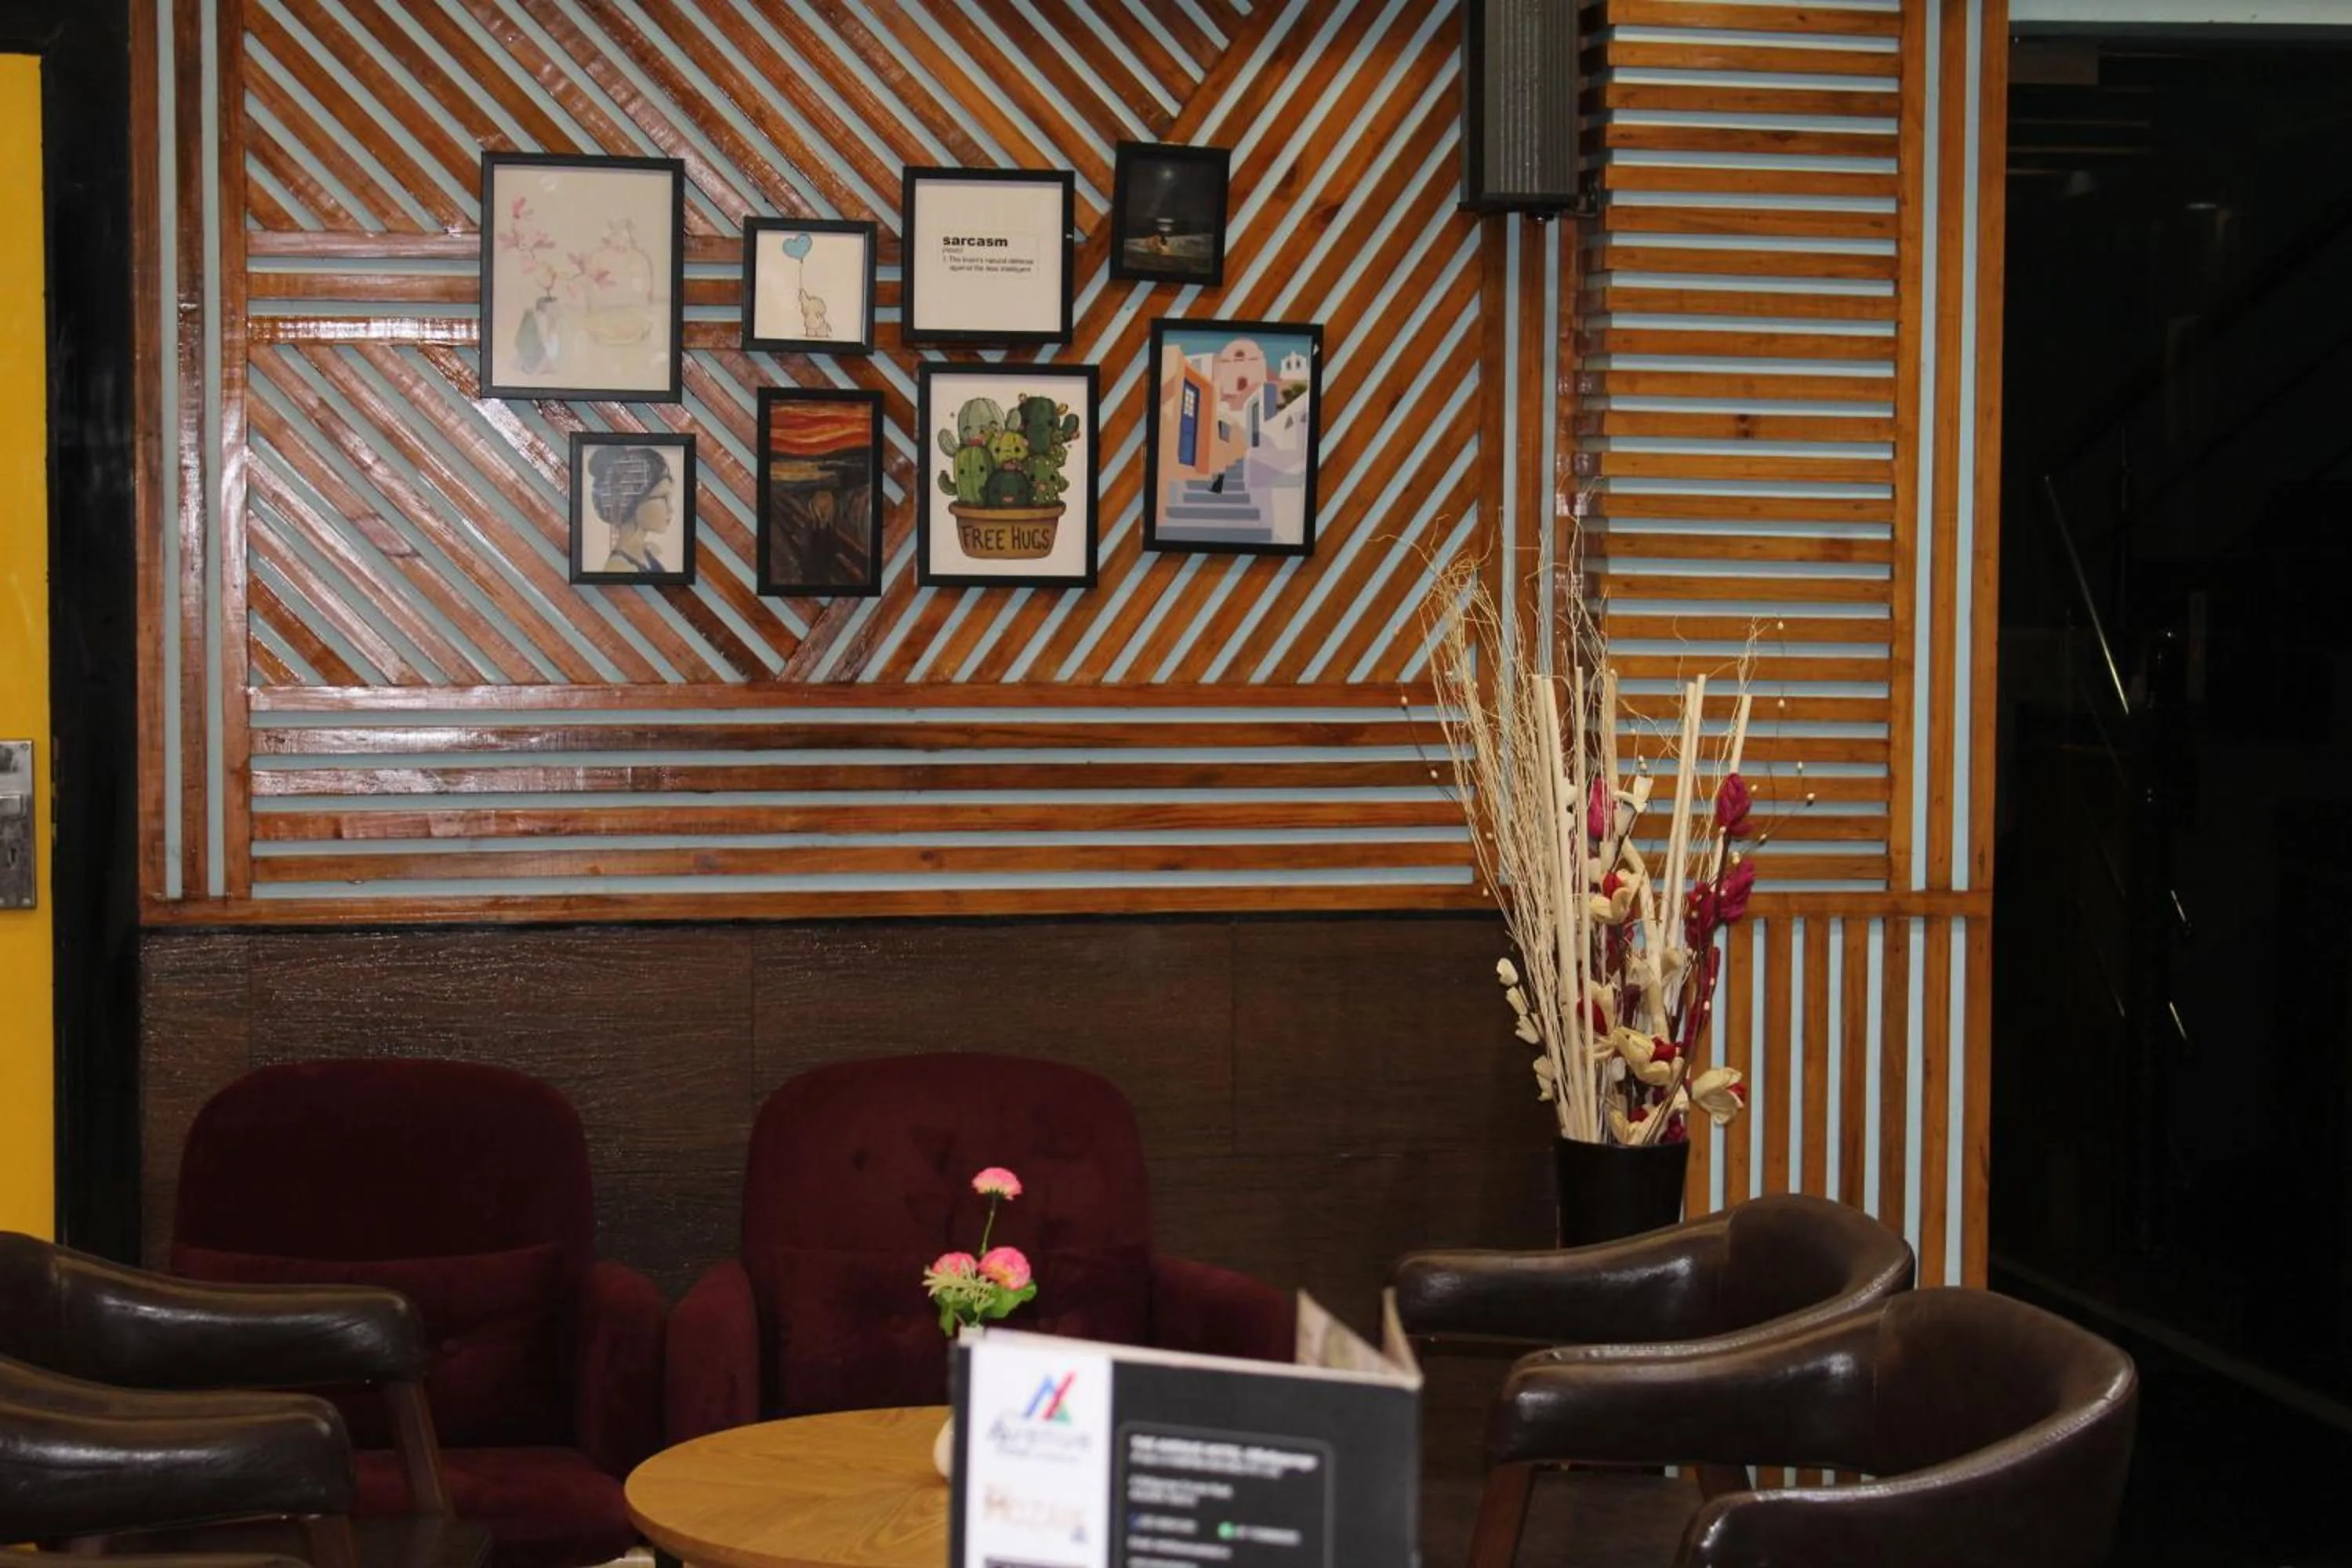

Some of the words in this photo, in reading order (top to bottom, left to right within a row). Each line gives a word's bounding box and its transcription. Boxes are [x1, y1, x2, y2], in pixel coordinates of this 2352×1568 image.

[942, 236, 1007, 247] sarcasm
[960, 525, 1007, 551] FREE
[1011, 524, 1051, 550] HUGS
